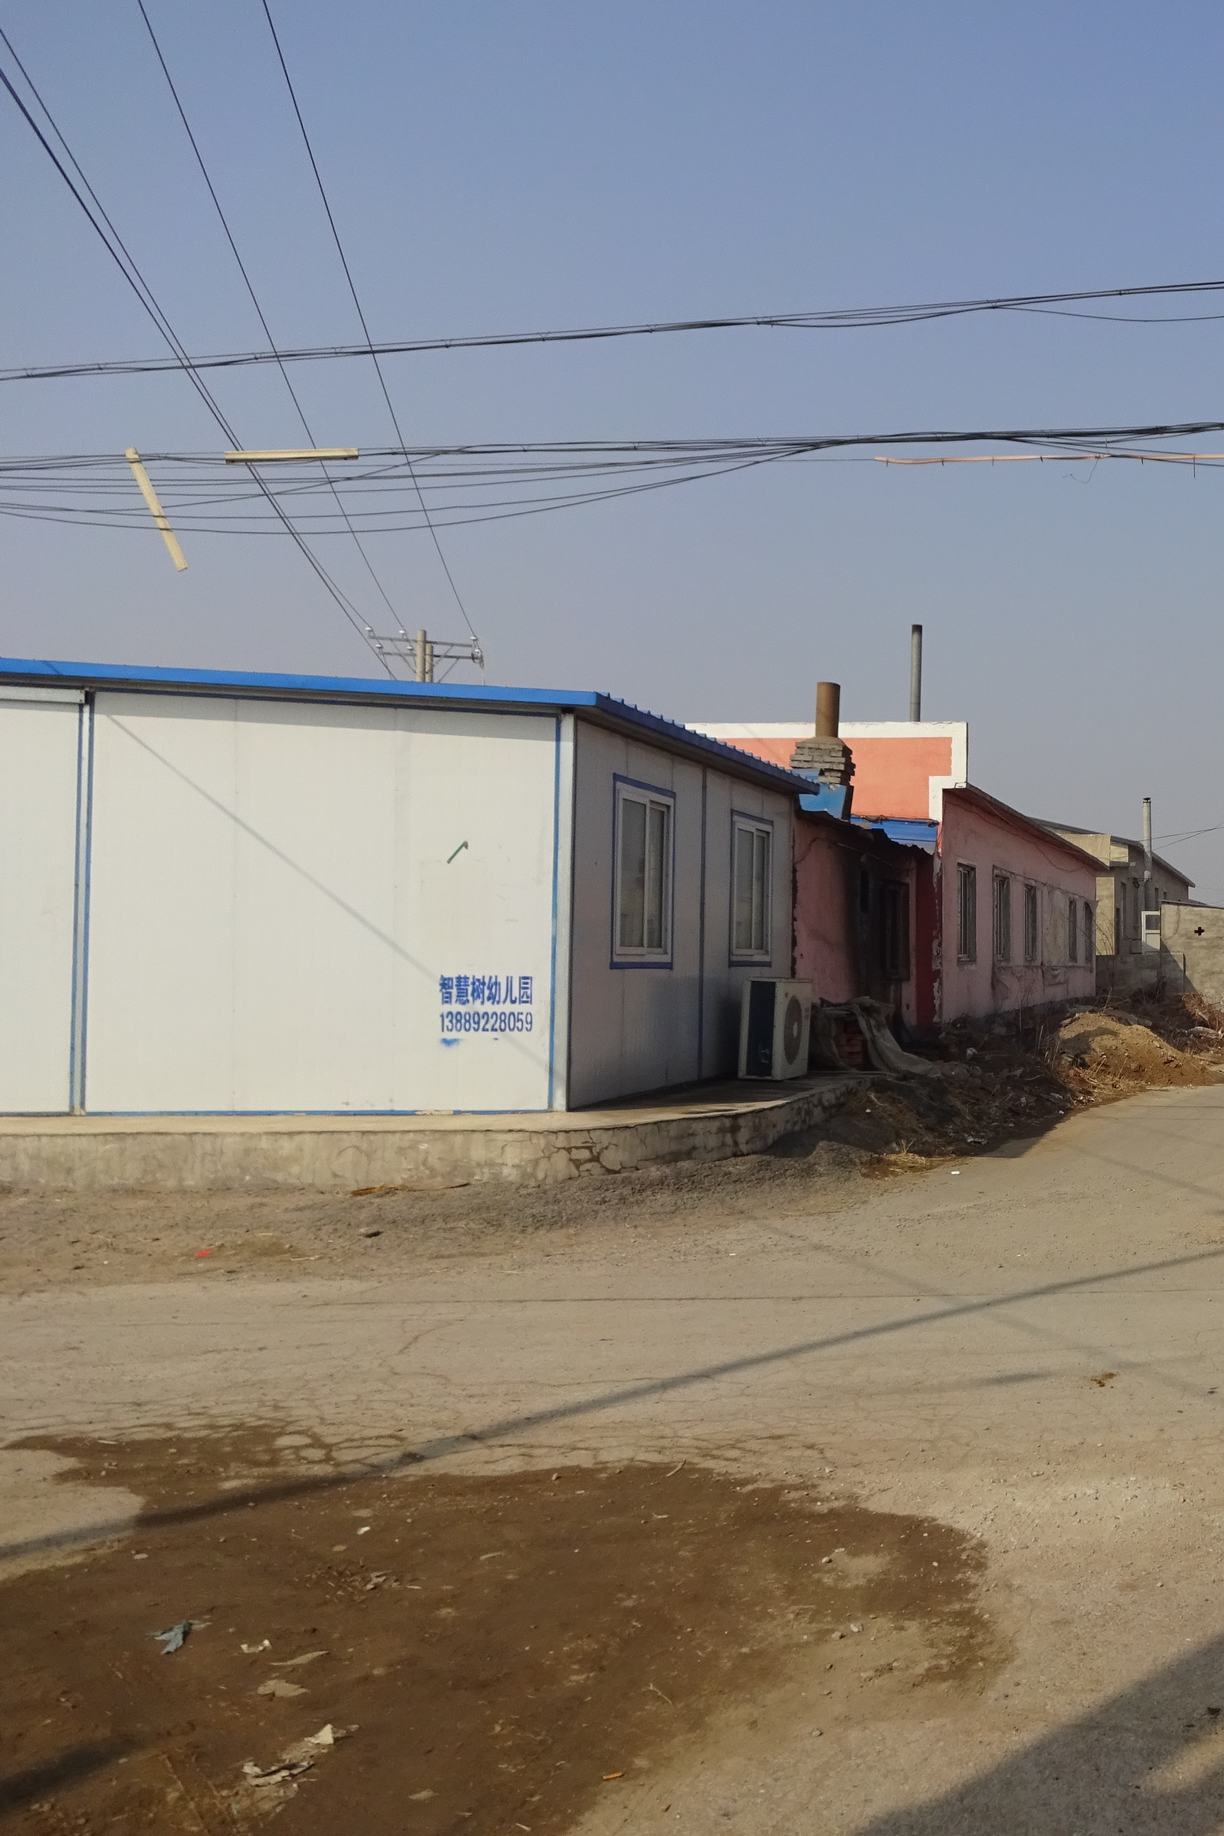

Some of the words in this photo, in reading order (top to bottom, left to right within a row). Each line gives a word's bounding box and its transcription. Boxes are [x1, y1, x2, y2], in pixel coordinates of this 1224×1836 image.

[439, 975, 533, 1005] 智慧树幼儿园
[440, 1011, 533, 1032] 13889228059
